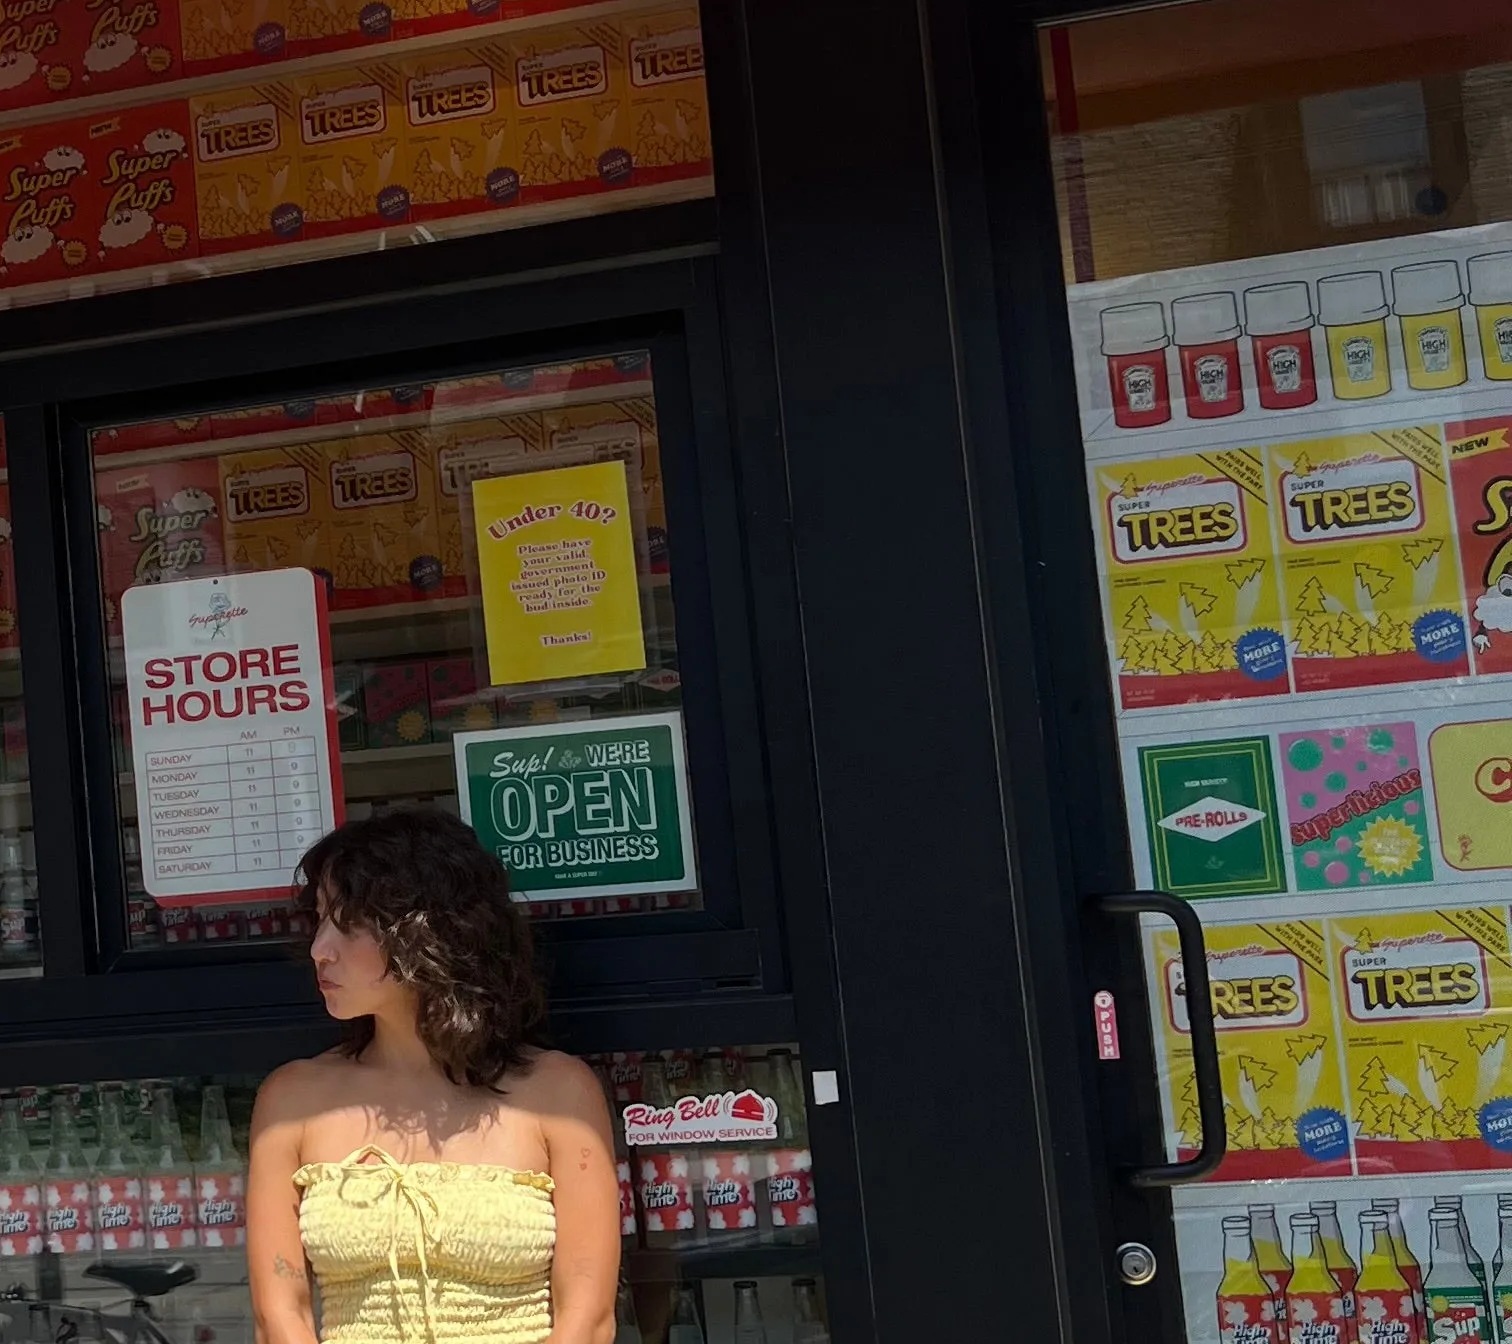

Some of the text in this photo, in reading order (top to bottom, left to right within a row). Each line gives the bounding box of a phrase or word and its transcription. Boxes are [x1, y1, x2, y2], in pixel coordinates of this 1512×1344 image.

[91, 1, 159, 41] Puffs
[521, 62, 601, 96] TREES
[411, 82, 490, 114] TREES
[306, 101, 380, 136] TREES
[200, 120, 275, 153] TREES
[102, 150, 177, 184] Super
[3, 167, 77, 201] Super
[107, 181, 174, 218] Puffs
[9, 197, 74, 234] Puffs
[1422, 340, 1447, 351] HIGH
[1272, 359, 1297, 370] HIGH
[1347, 350, 1370, 361] HIGH
[1128, 378, 1151, 389] HIGH
[1200, 369, 1224, 380] HIGH
[1452, 438, 1488, 454] NEW
[337, 468, 413, 499] TREES
[1291, 480, 1324, 490] SUPER
[231, 482, 305, 514] TREES
[1118, 502, 1150, 511] SUPER
[1290, 481, 1415, 531] TREES
[131, 506, 205, 542] Super
[488, 501, 617, 539] Under 40?
[1118, 502, 1238, 551] TREES
[518, 539, 592, 555] Please have
[520, 560, 595, 580] government
[522, 555, 552, 568] your
[511, 570, 606, 591] issued photo ID
[519, 584, 601, 602] ready for the
[525, 602, 549, 613] bud
[542, 632, 591, 646] Thanks!
[1420, 626, 1459, 643] MORE
[1244, 642, 1280, 659] MORE
[145, 644, 301, 689] STORE
[142, 680, 310, 726] HOURS
[240, 726, 300, 740] AM PM
[150, 754, 192, 766] SUNDAY
[489, 739, 651, 779] Sup! WE'RE
[152, 772, 198, 784] MONDAY
[153, 789, 200, 802] TUESDAY
[490, 767, 658, 842] OPEN
[155, 806, 220, 820] WEDNESDAY
[1175, 810, 1248, 828] PRE-ROLLS
[156, 825, 212, 838] THURSDAY
[157, 845, 193, 856] FRIDAY
[496, 834, 659, 870] FOR BUSINESS
[159, 862, 213, 874] SATURDAY
[1352, 957, 1386, 967] SUPER
[1351, 962, 1480, 1011] TREES
[1175, 974, 1299, 1019] REES
[1100, 1010, 1114, 1057] PUSH
[627, 1098, 720, 1130] Ring Bell
[629, 1127, 774, 1142] FOR WINDOW SERVICE
[1304, 1122, 1342, 1142] MORE
[1234, 1322, 1268, 1337] High
[1302, 1321, 1337, 1336] High
[1371, 1320, 1406, 1335] High
